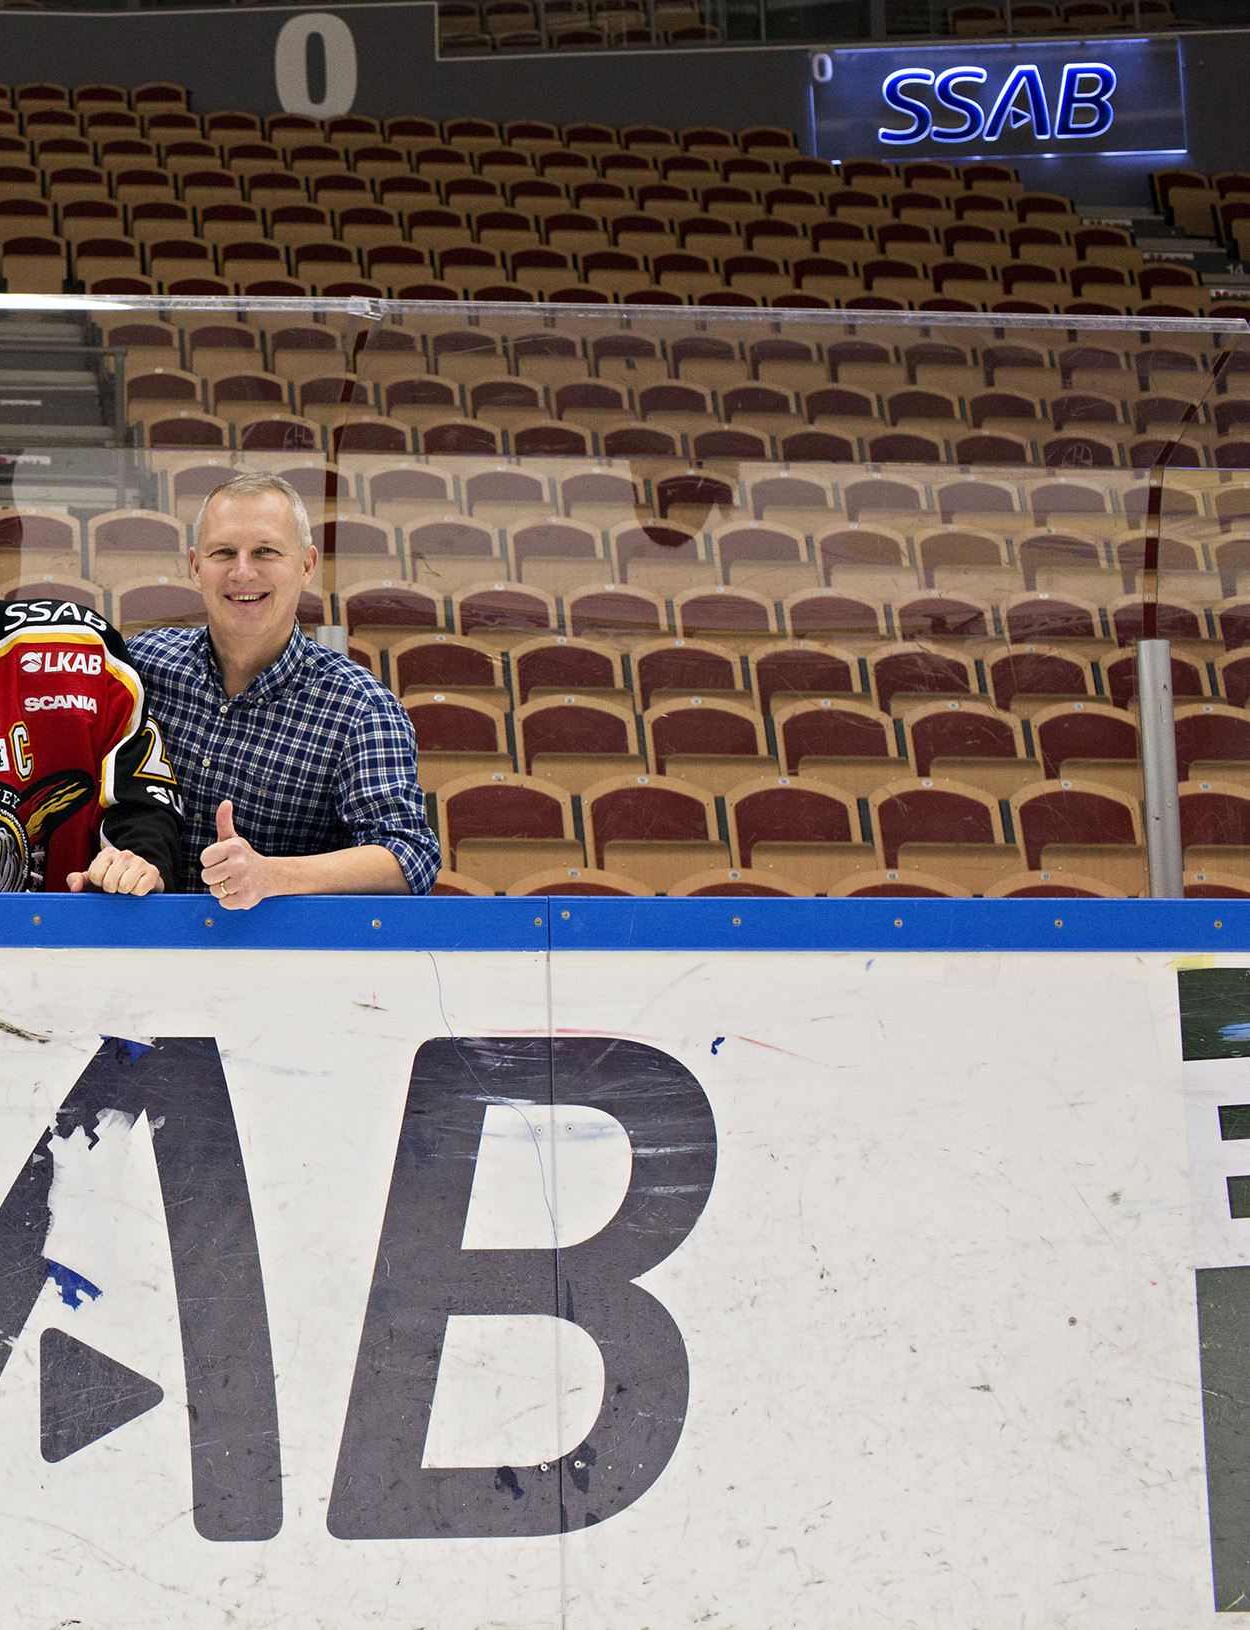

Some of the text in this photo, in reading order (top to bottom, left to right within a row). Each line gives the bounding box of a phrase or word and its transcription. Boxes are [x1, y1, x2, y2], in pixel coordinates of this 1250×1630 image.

[878, 62, 1117, 145] SSAB
[4, 601, 107, 632] SSAB
[44, 651, 102, 675] LKAB
[24, 694, 97, 714] SCANIA
[8, 720, 34, 782] C
